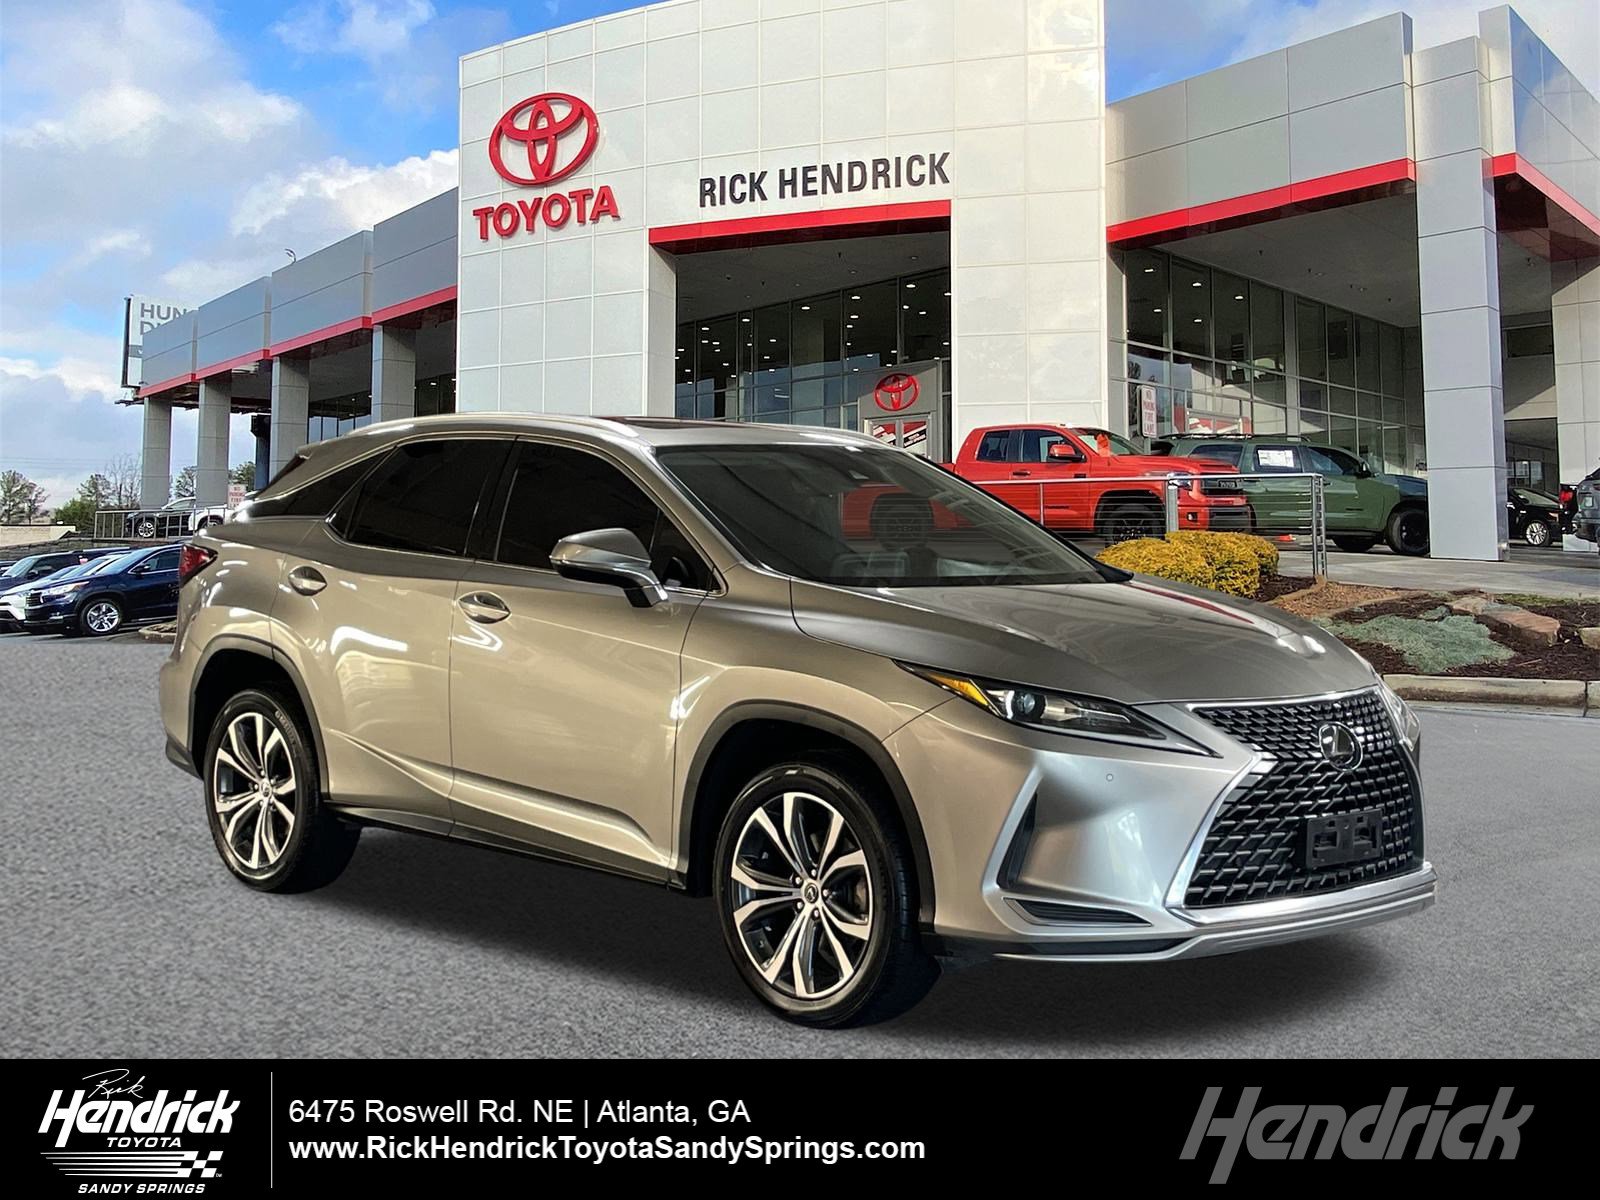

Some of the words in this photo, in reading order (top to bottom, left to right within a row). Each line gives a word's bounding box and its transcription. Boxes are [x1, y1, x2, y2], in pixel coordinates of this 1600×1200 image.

[699, 170, 769, 208] RICK
[778, 152, 950, 199] HENDRICK
[472, 185, 620, 241] TOYOTA
